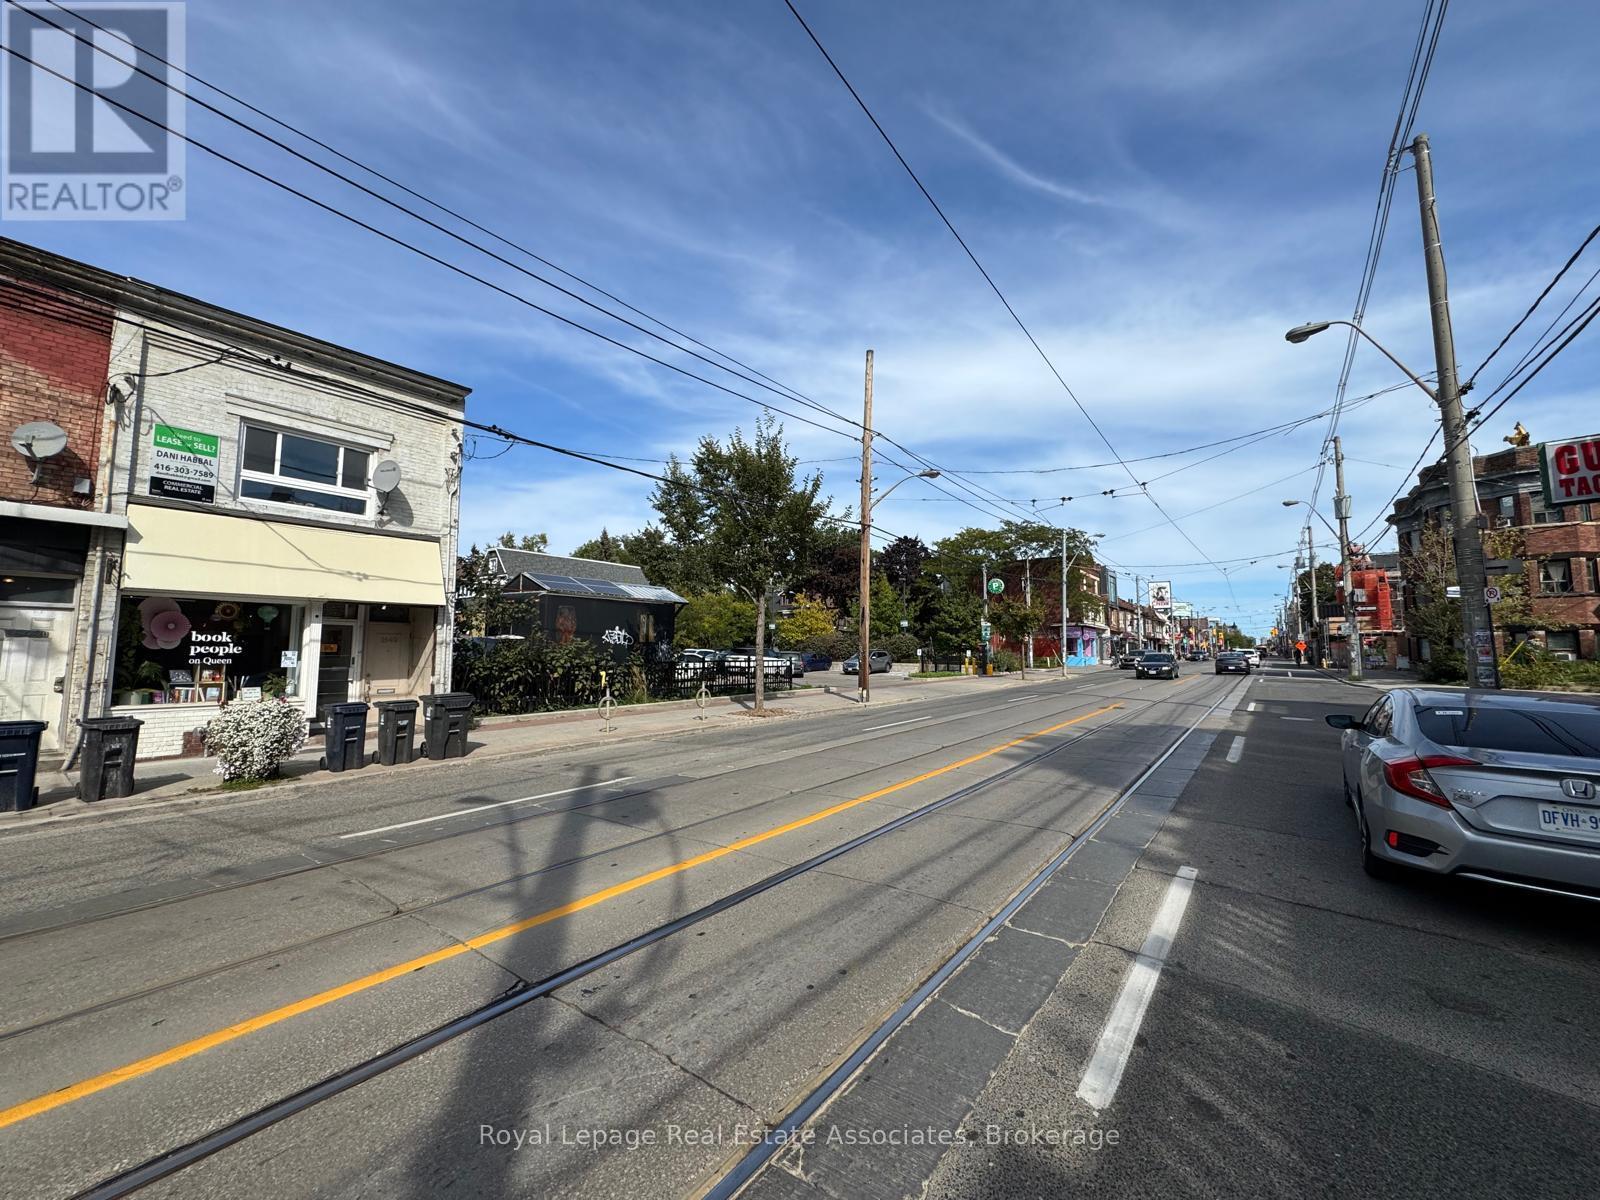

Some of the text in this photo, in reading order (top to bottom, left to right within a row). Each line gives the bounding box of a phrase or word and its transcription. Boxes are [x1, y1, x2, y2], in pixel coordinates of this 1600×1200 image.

[156, 435, 183, 447] LEASE
[193, 442, 216, 453] SELL?
[156, 450, 214, 467] DANI HABBAL
[154, 463, 214, 479] 416-303-7589
[162, 480, 204, 491] COMMERCIAL
[180, 487, 202, 495] ESTATE
[191, 631, 233, 643] book
[189, 643, 243, 656] people
[202, 656, 232, 665] Queen
[1542, 810, 1580, 828] DFVH
